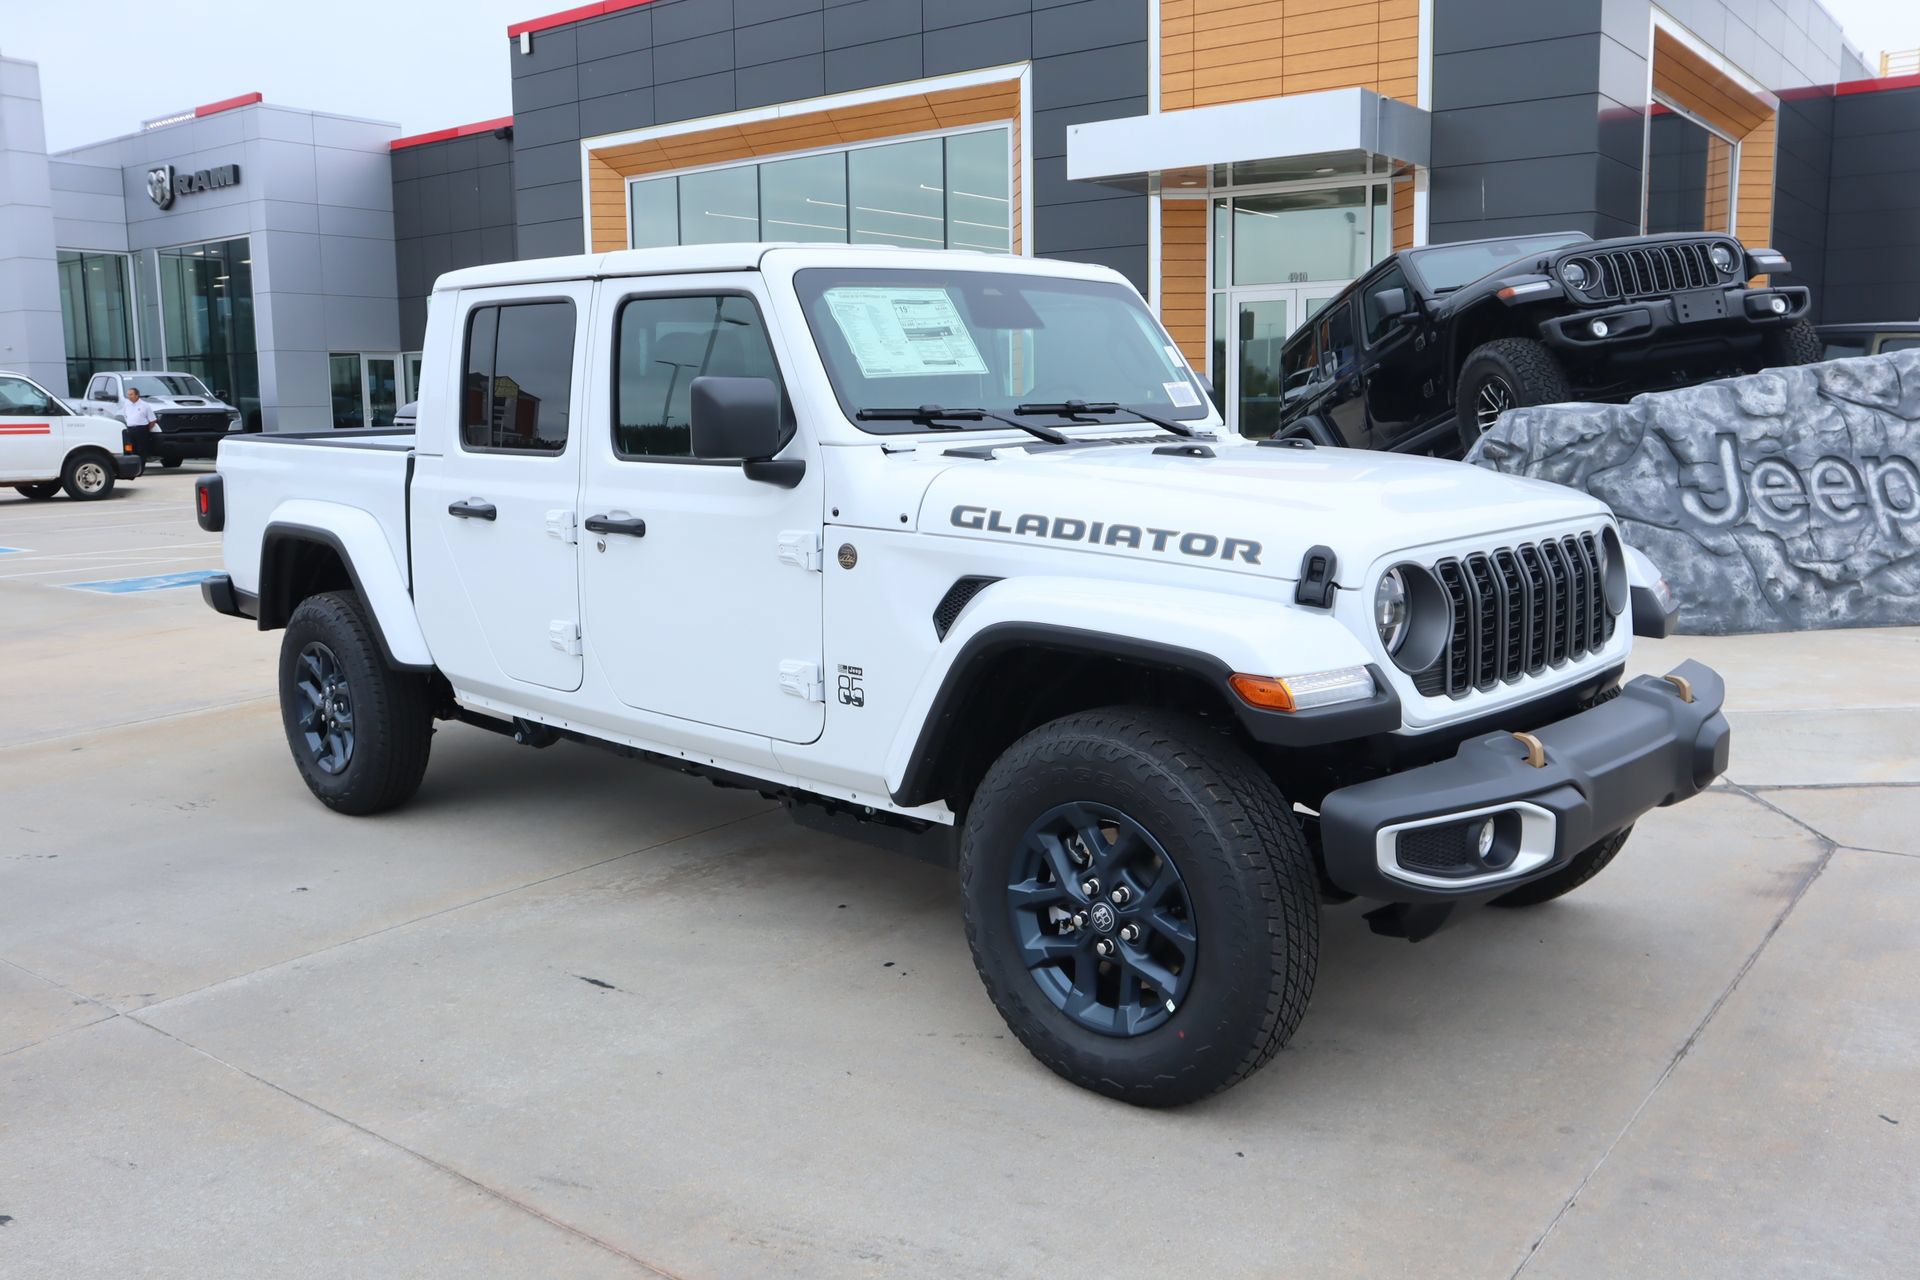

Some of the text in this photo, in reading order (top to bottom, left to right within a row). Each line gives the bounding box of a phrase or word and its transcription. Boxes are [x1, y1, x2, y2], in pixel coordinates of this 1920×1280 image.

[173, 163, 240, 195] RAM
[1681, 432, 1920, 539] Jeep
[950, 504, 1264, 566] GLADIATOR
[848, 666, 862, 675] Jeep
